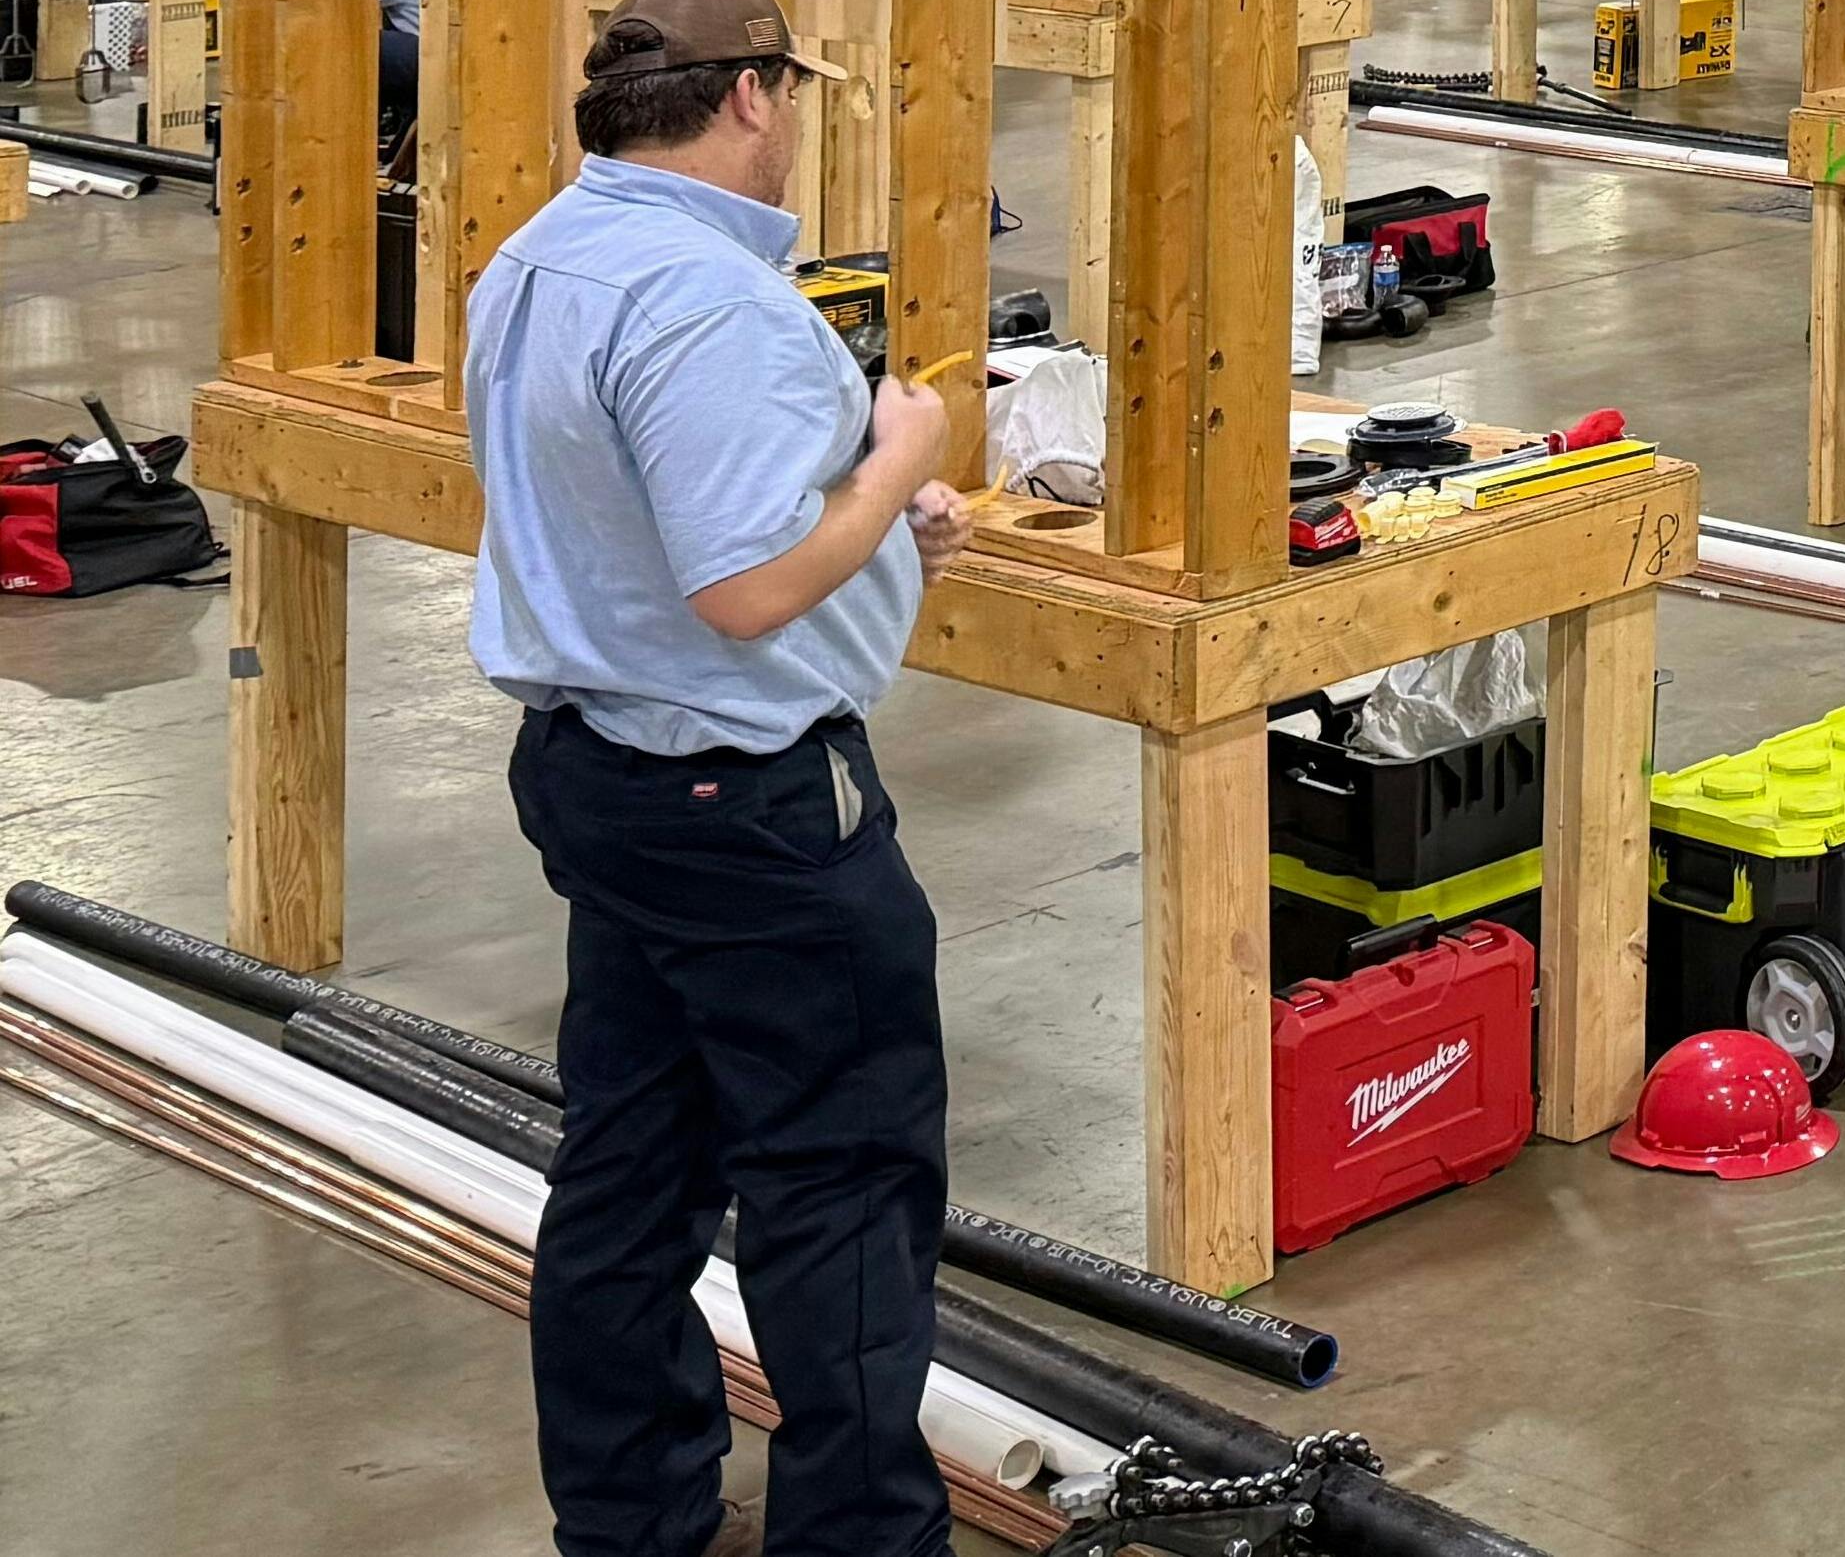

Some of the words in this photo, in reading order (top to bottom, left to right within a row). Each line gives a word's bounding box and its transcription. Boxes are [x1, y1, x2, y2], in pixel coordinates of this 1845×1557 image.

[1705, 45, 1728, 58] XR
[1344, 1038, 1471, 1129] Milwaukee
[1166, 1281, 1206, 1308] USA
[1225, 1301, 1295, 1340] TYLER
